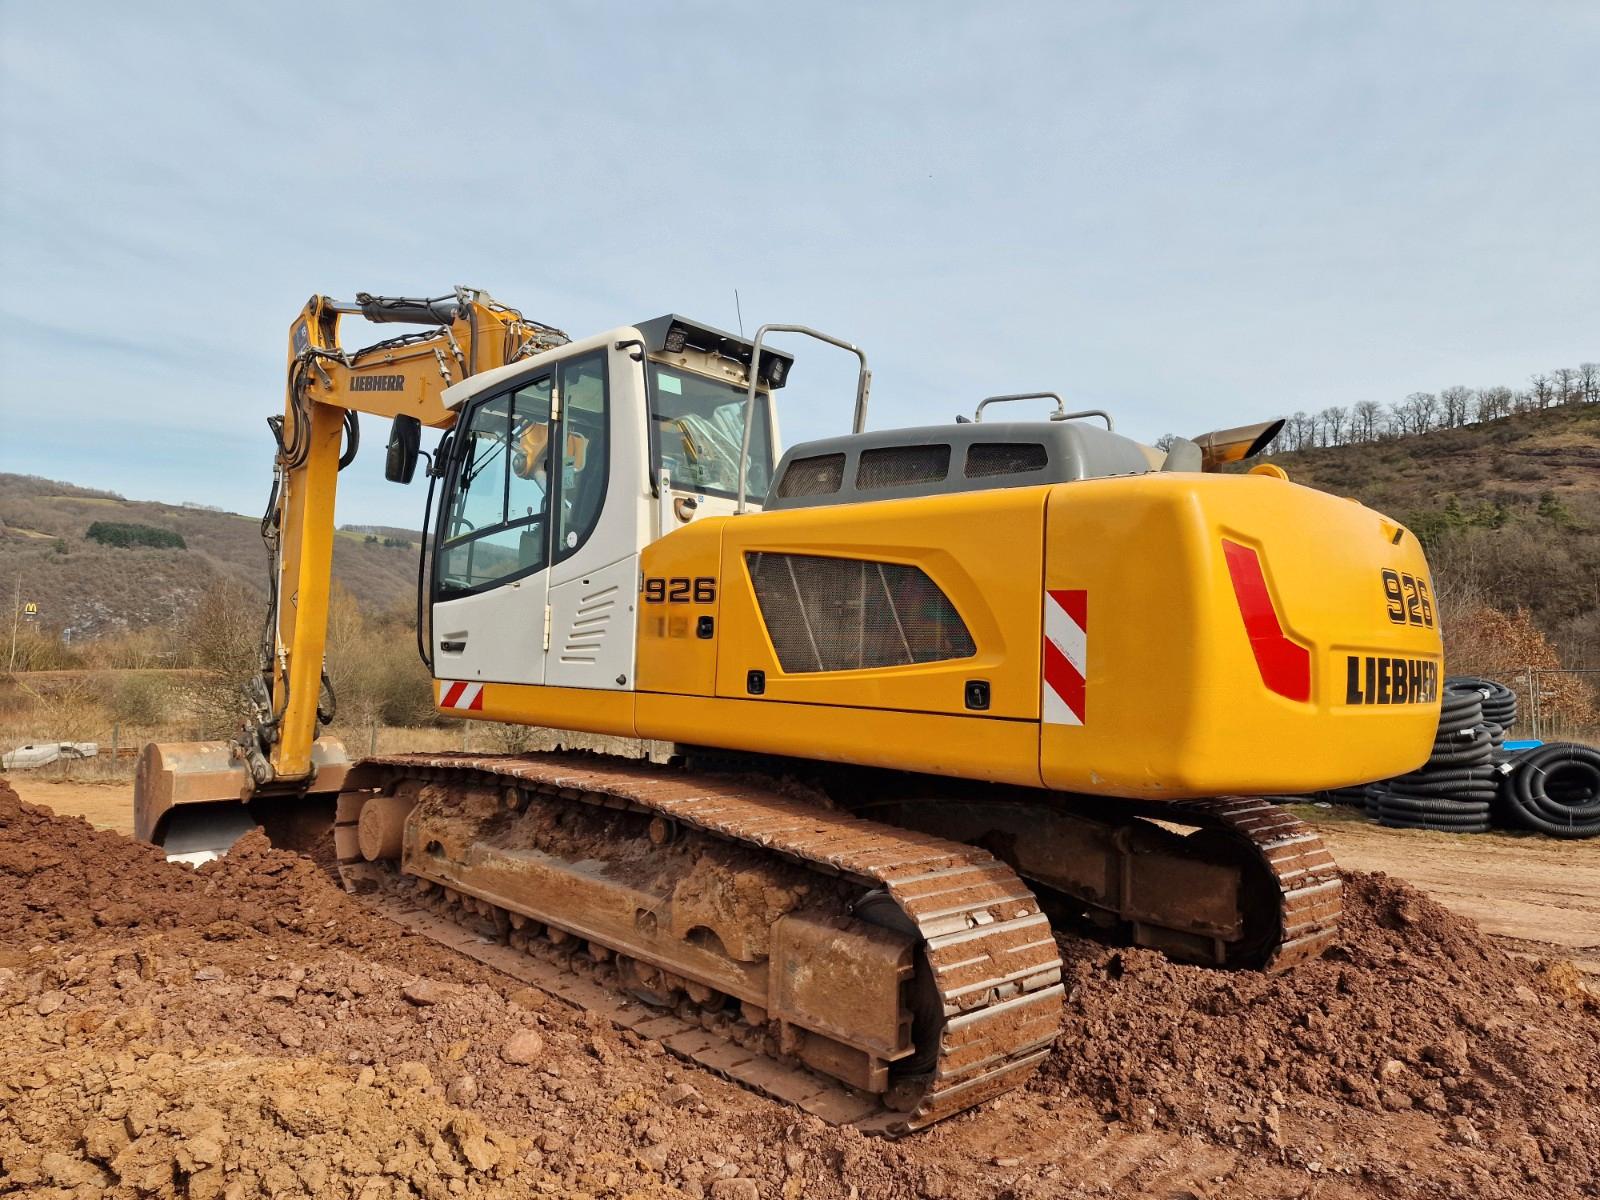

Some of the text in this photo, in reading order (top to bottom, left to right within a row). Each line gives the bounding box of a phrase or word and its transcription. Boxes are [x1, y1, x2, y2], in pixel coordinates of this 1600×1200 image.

[350, 375, 404, 391] LIEBHERR
[646, 577, 716, 604] 926
[1382, 568, 1433, 628] 926
[1346, 656, 1438, 705] LIEBHER
